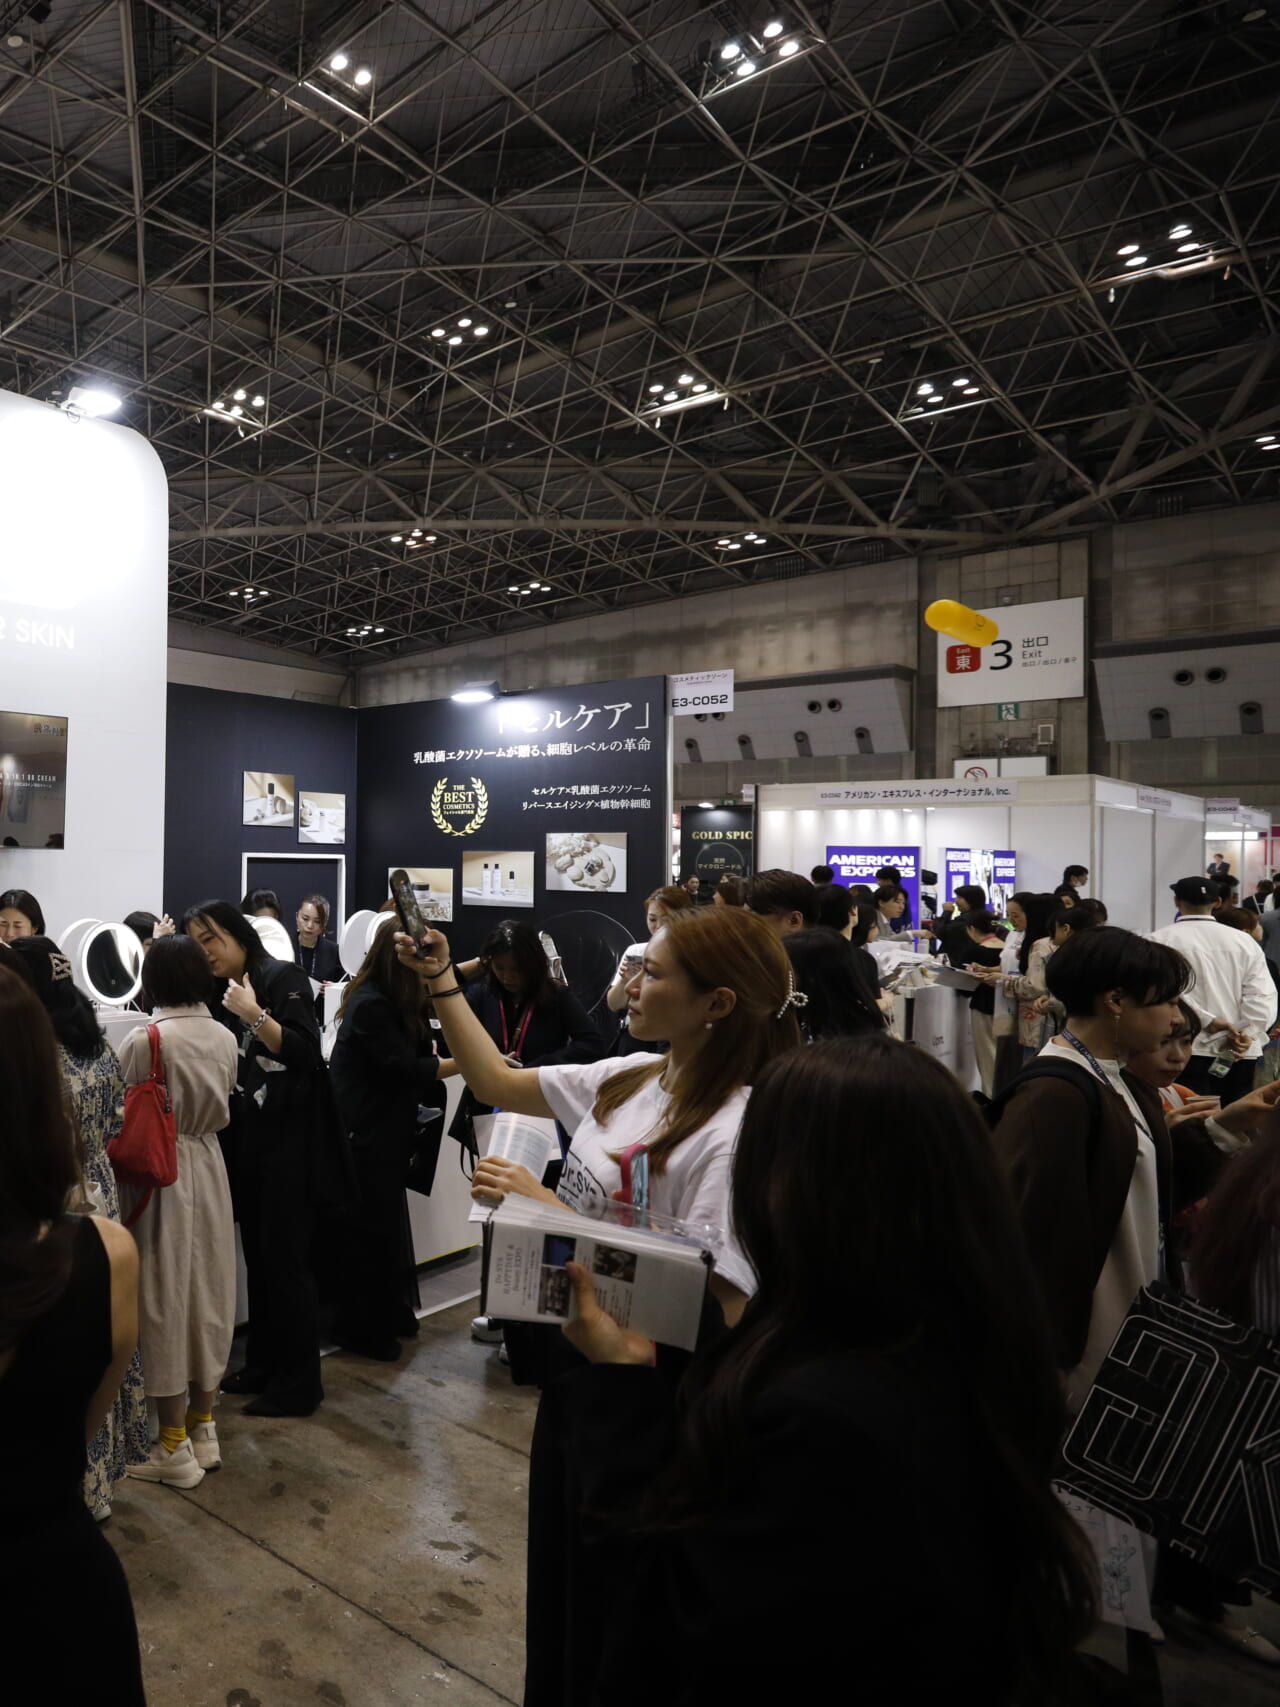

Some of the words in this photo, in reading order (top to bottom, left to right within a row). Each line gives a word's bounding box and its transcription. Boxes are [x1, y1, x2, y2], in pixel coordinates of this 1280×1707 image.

[15, 618, 75, 649] SKIN
[1022, 636, 1049, 648] 出口
[989, 639, 1013, 671] 3
[1022, 650, 1043, 659] Exit
[955, 655, 971, 670] 東
[672, 695, 728, 708] E3-C052
[444, 791, 475, 803] BEST
[692, 831, 723, 840] GOLD
[829, 854, 915, 866] AMERICAN
